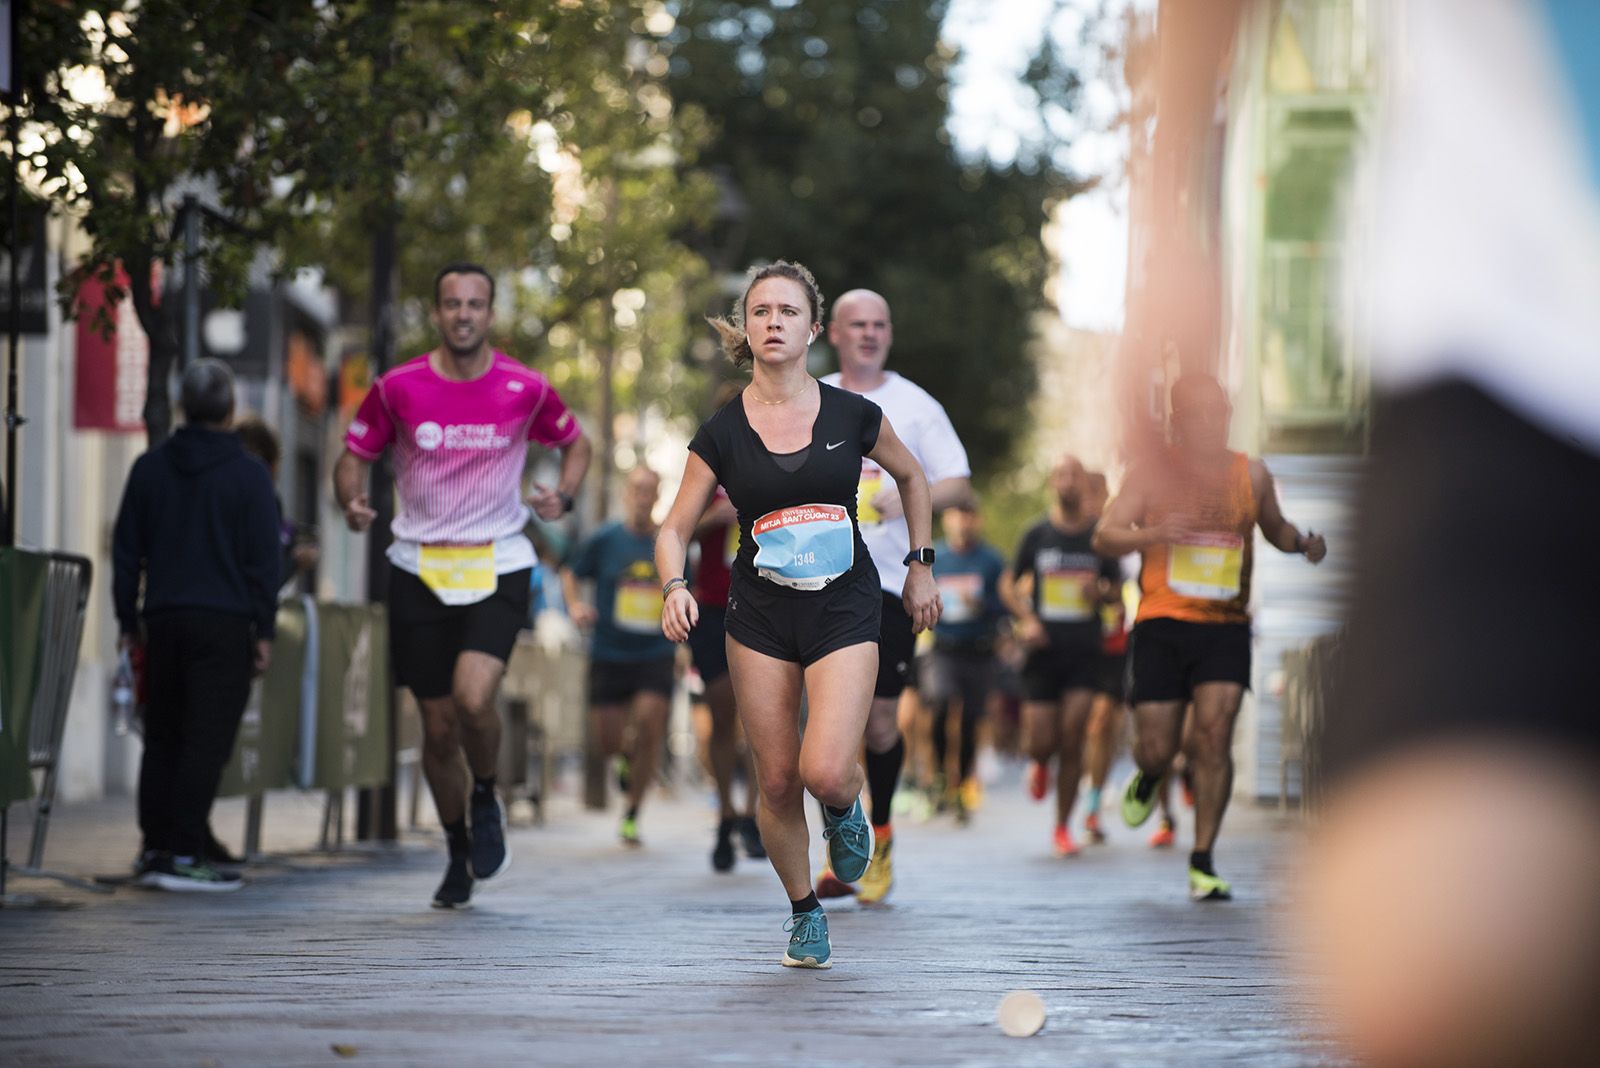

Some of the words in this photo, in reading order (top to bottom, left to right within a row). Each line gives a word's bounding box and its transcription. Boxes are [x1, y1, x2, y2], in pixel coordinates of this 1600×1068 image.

[444, 424, 495, 437] ACTIVE
[760, 519, 781, 530] MITJA
[783, 514, 803, 524] SANT
[803, 512, 829, 521] CUGAT
[794, 552, 815, 566] 1348
